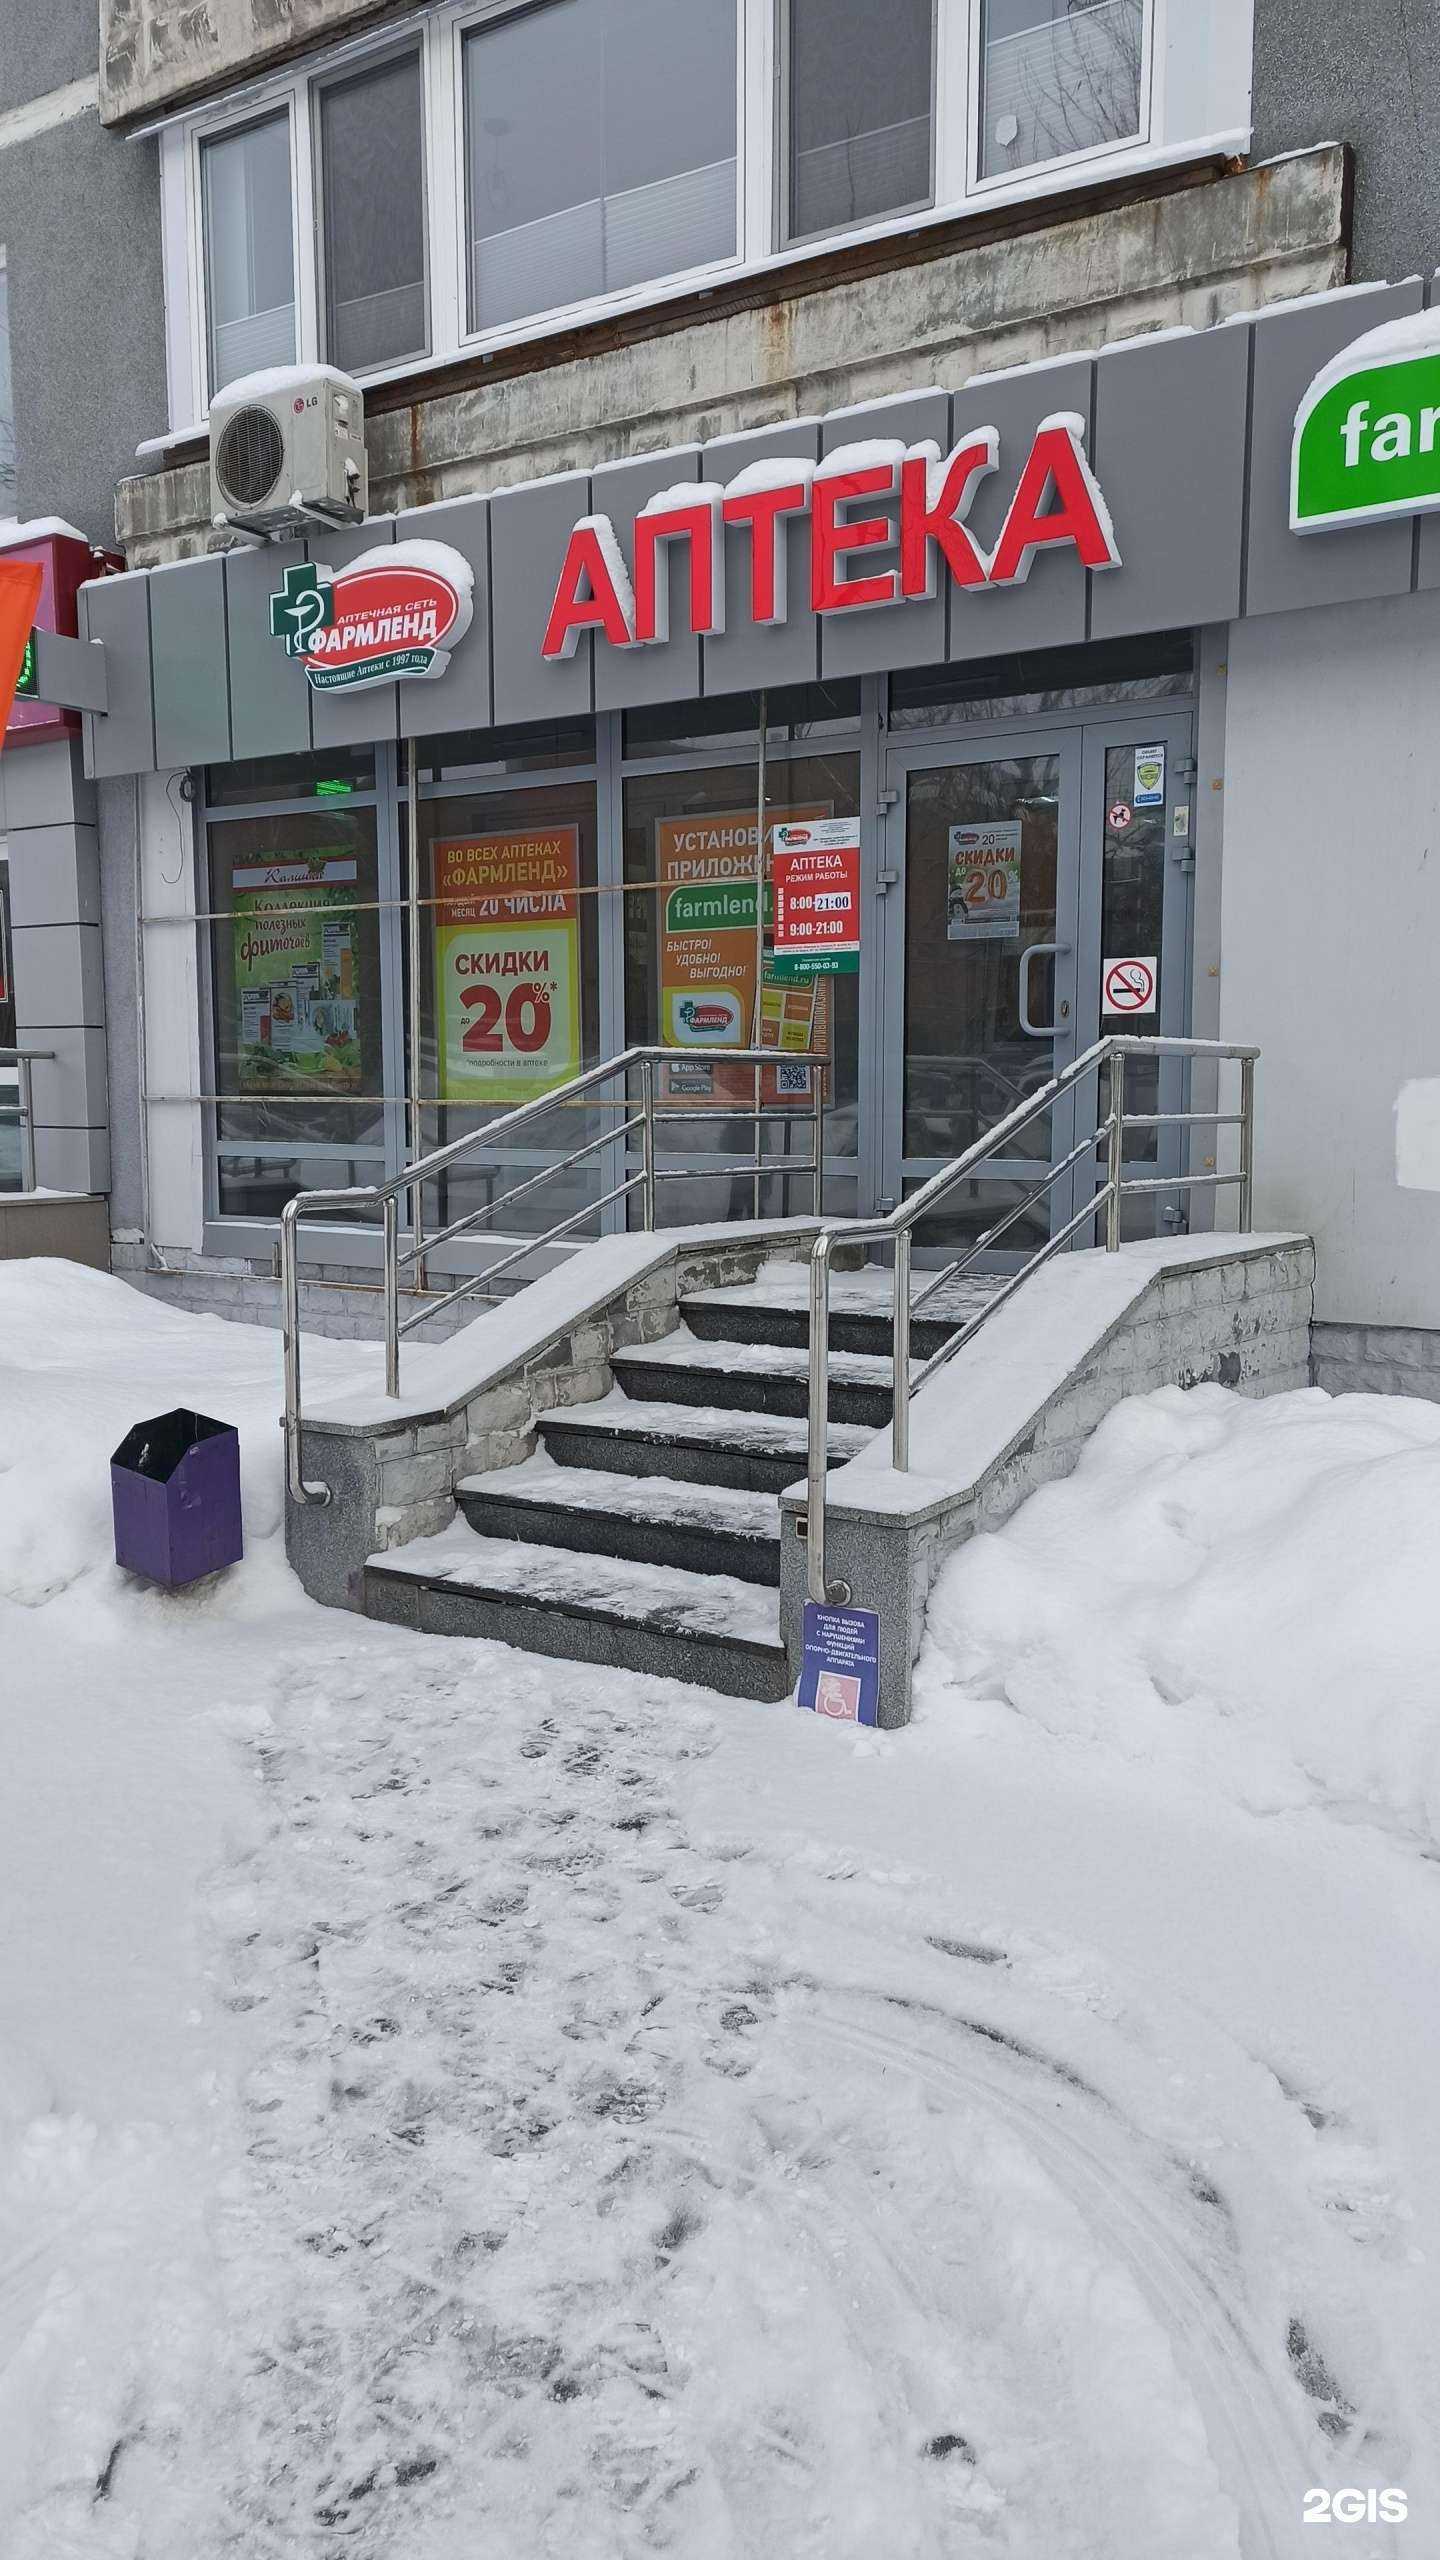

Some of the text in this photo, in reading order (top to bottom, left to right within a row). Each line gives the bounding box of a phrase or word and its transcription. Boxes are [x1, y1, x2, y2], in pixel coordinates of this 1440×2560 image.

[306, 396, 318, 408] LG
[541, 424, 1117, 659] АПТЕКА
[337, 598, 437, 624] АПТЕЧНАЯ СЕТЬ
[308, 609, 437, 654] ФАРМЛЕНД
[314, 653, 428, 684] Настоящие Аптеки с 1997 года
[982, 834, 996, 846] 20
[447, 840, 561, 863] ВО ВСЕХ АПТЕКАХ
[955, 847, 1015, 866] СКИДКИ
[790, 855, 843, 870] АПТЕКА
[442, 859, 568, 887] «ФАРМЛЕНД»
[785, 870, 848, 883] РЕЖИМ РАБОТЫ
[504, 893, 567, 914] ЧИСЛА
[255, 917, 306, 935] полезных
[789, 920, 843, 937] 9:00-21:00
[666, 939, 712, 952] БЫСТРО!
[454, 950, 549, 977] СКИДКИ
[676, 952, 721, 967] УДОБНО!
[690, 965, 746, 979] ВЫГОДНО!
